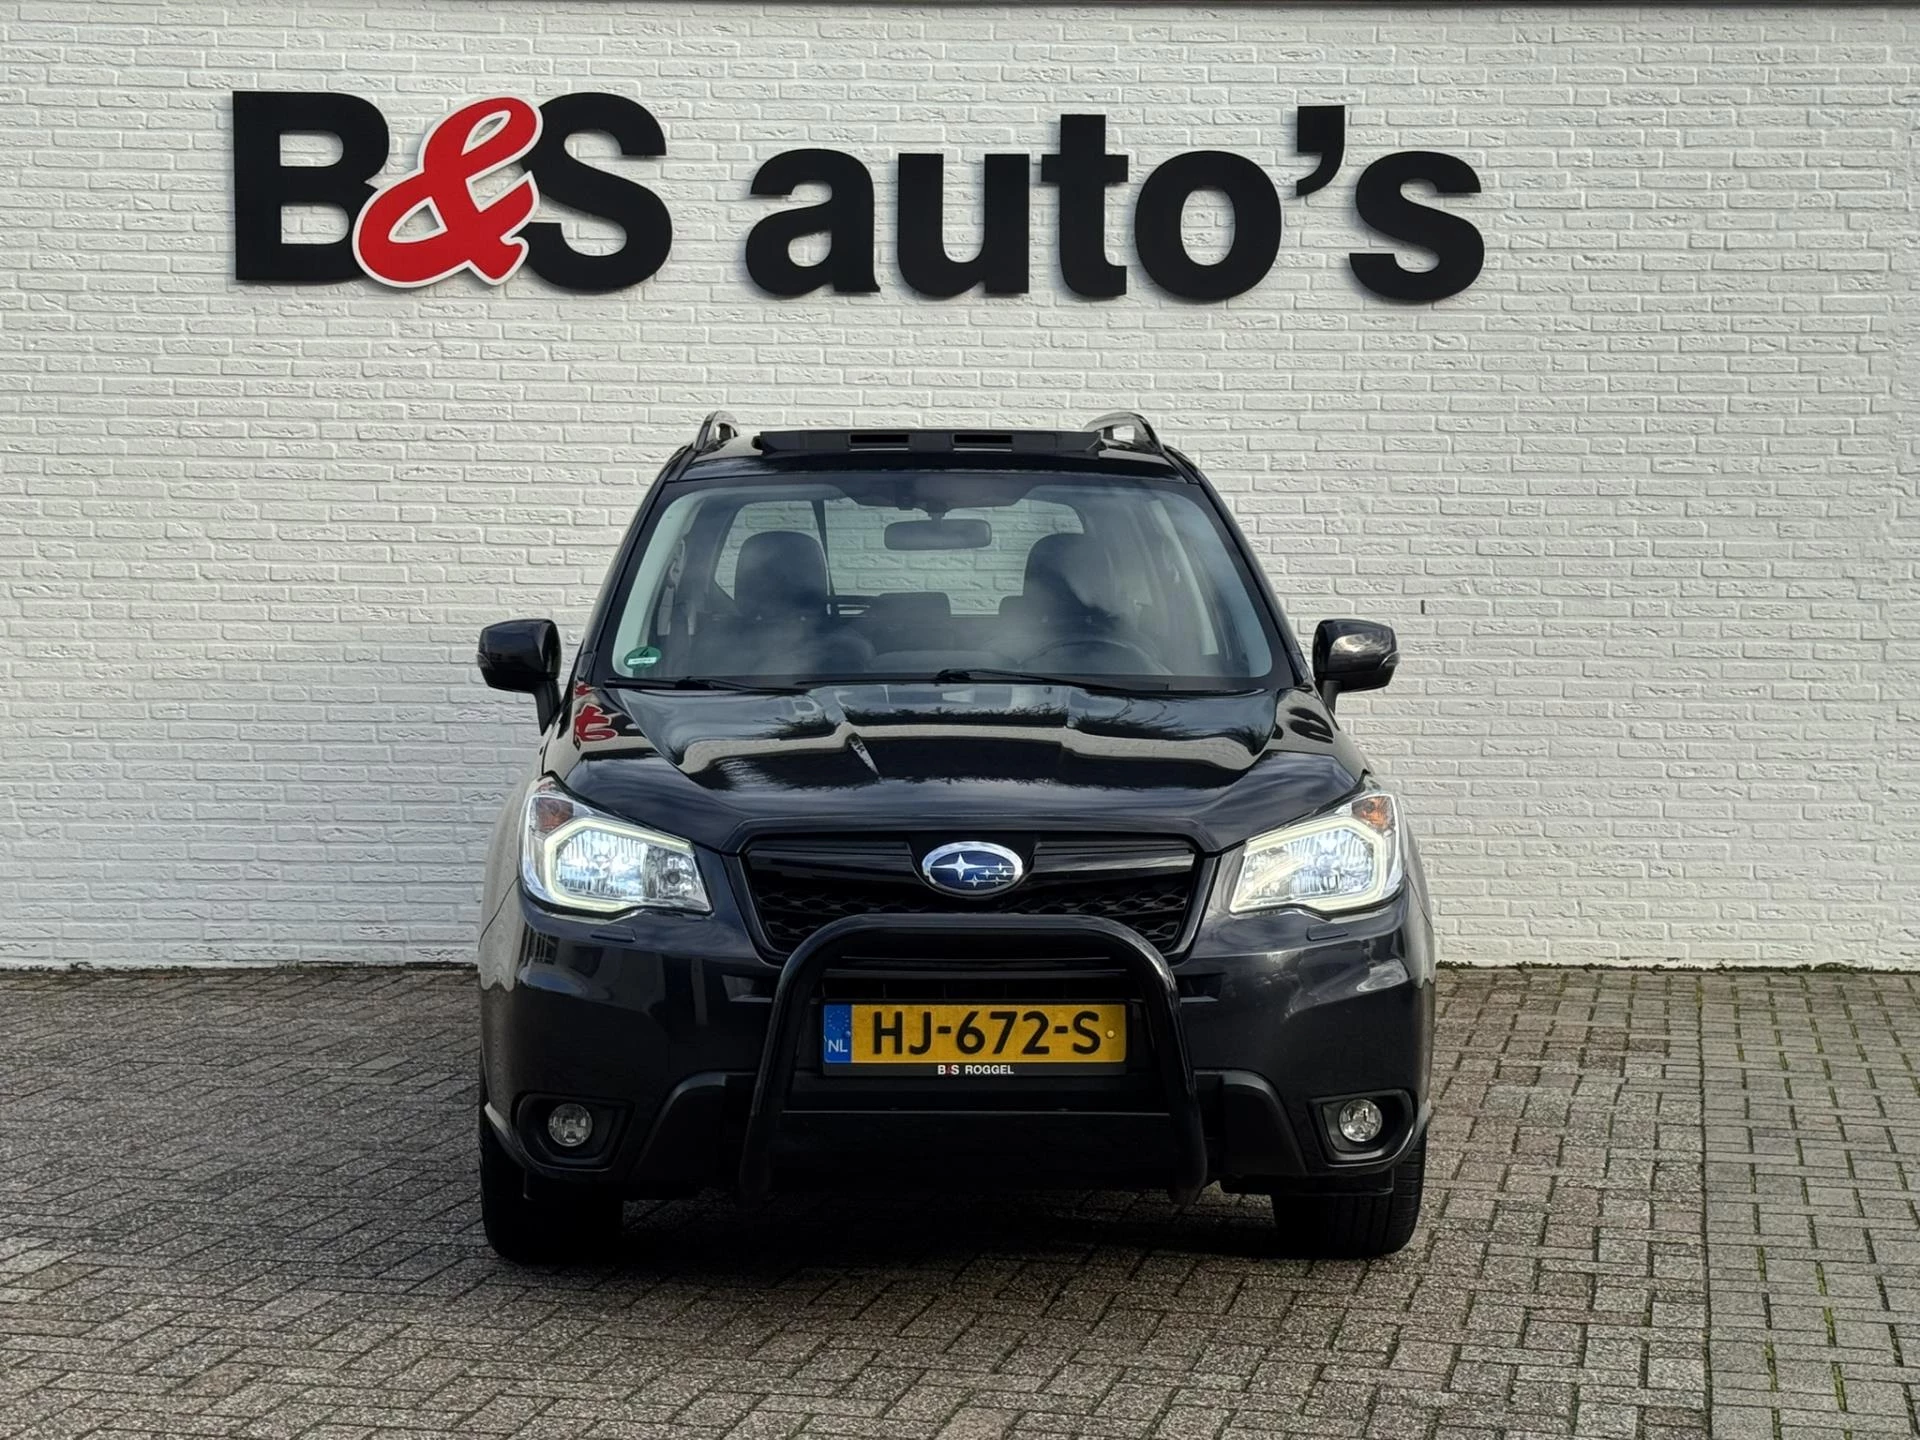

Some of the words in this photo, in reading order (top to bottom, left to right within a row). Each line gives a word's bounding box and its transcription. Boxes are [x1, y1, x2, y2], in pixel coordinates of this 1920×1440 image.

[233, 91, 673, 293] B&S
[745, 105, 1486, 303] auto's
[828, 1039, 849, 1053] NL
[873, 1011, 1101, 1055] HJ-672-S
[964, 1064, 1015, 1075] ROGGEL
